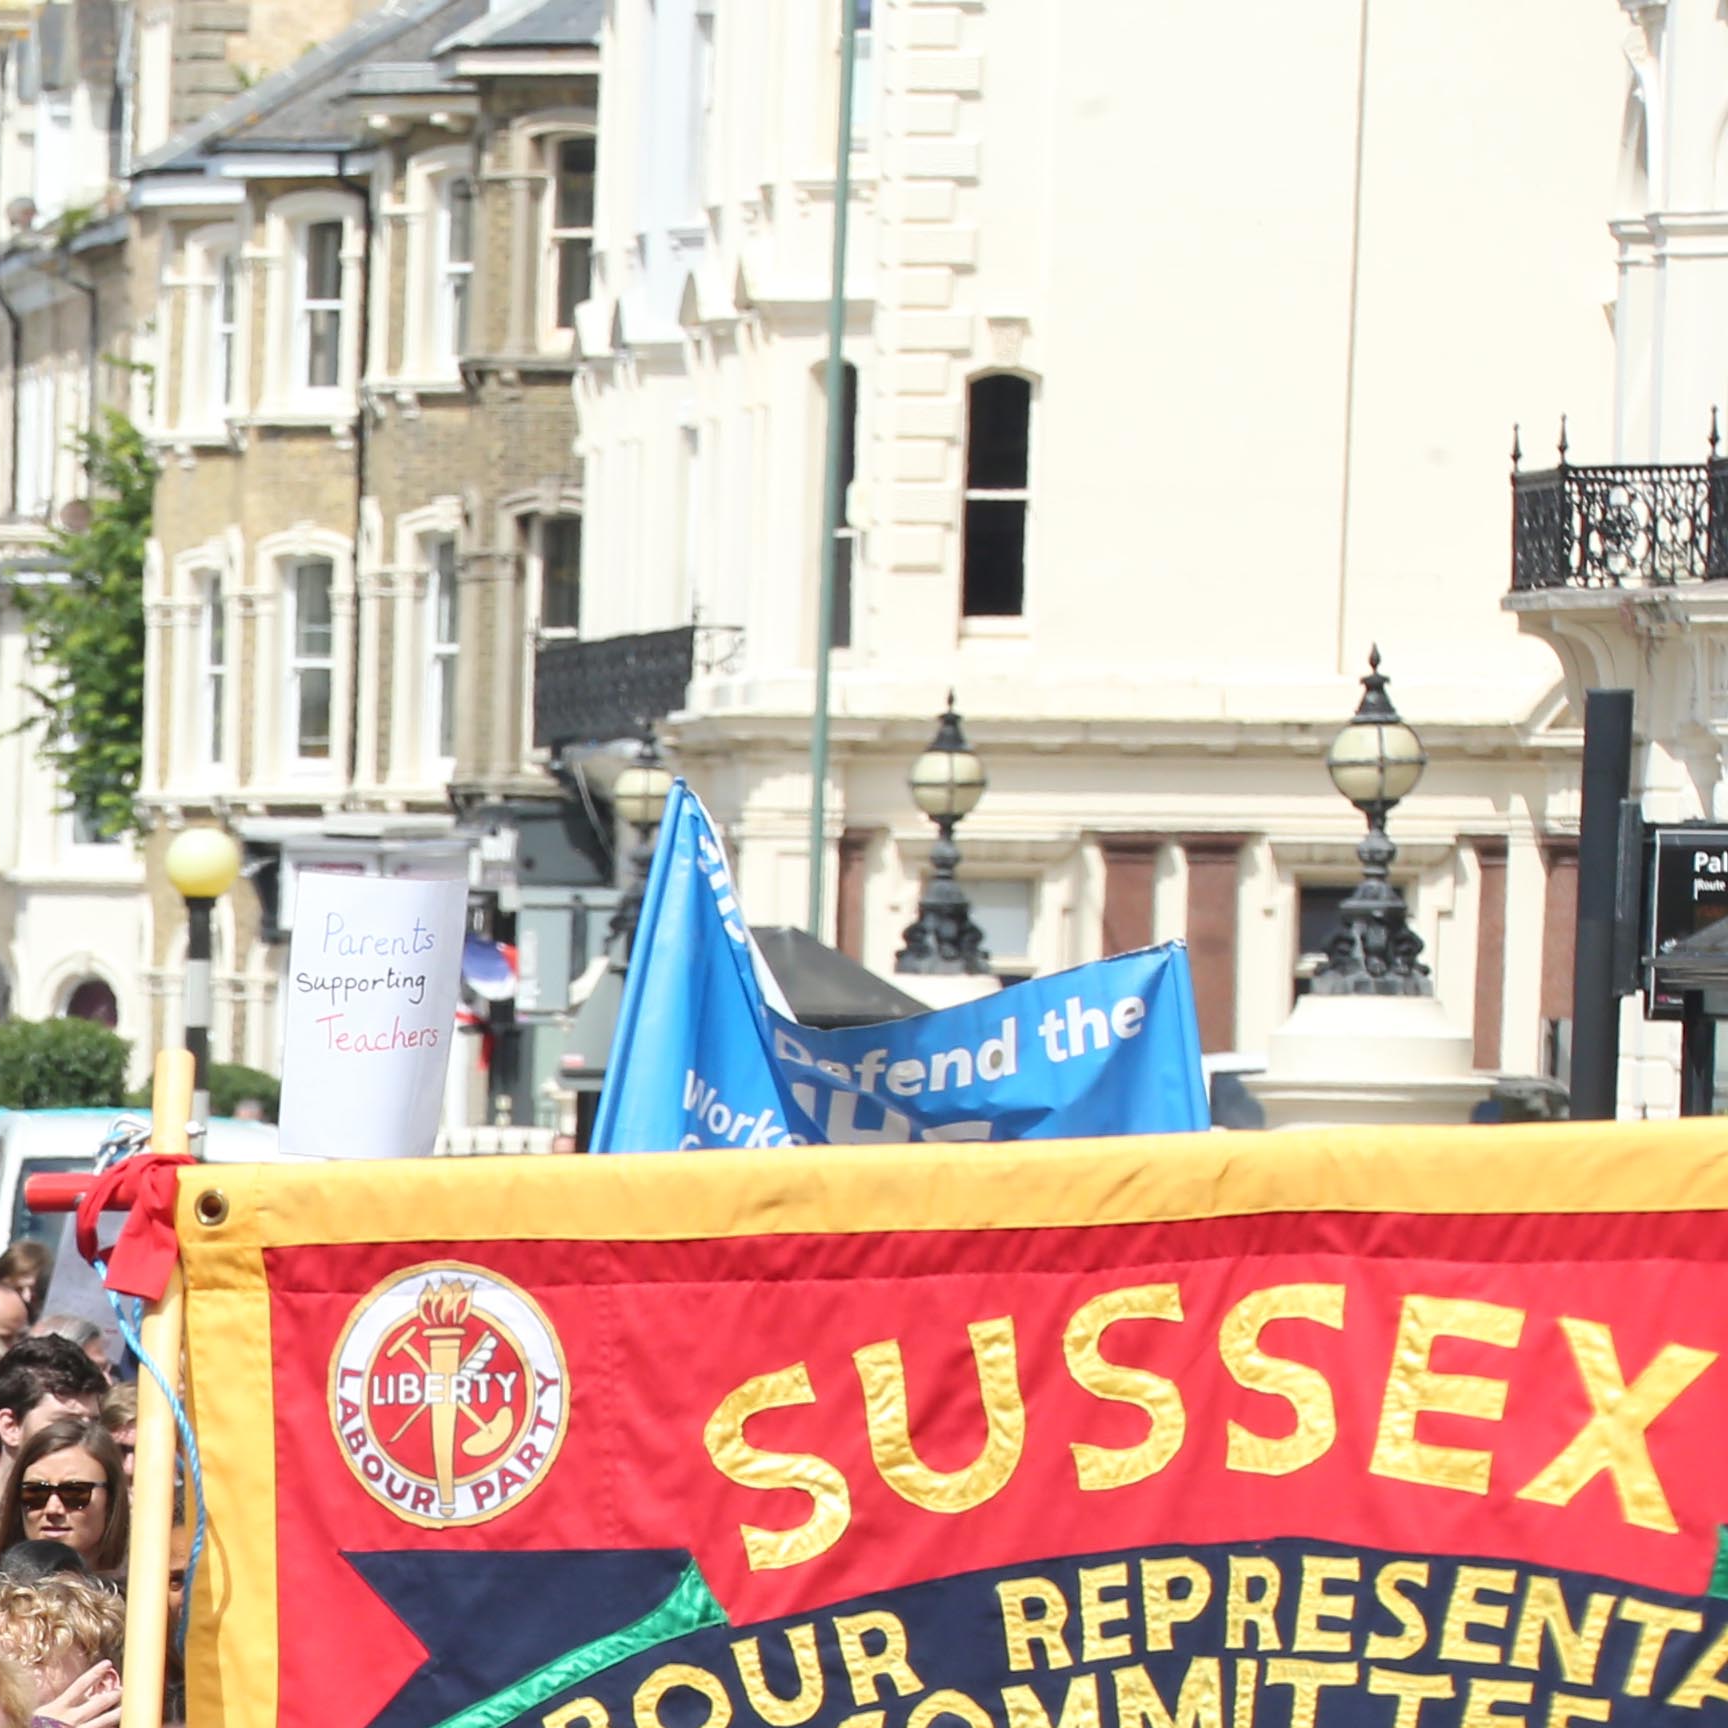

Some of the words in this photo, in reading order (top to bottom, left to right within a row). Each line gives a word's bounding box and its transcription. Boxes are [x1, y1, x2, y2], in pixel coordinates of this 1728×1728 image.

[1695, 851, 1728, 873] Pal
[323, 912, 435, 955] Parents
[316, 1014, 440, 1052] Teachers
[1038, 995, 1145, 1064] the
[373, 1371, 517, 1405] LIBERTY
[338, 1367, 435, 1513] LABOUR
[471, 1370, 559, 1510] PARTY
[704, 1283, 1718, 1570] SUSSEX
[996, 1556, 1728, 1709] REPRESENTA
